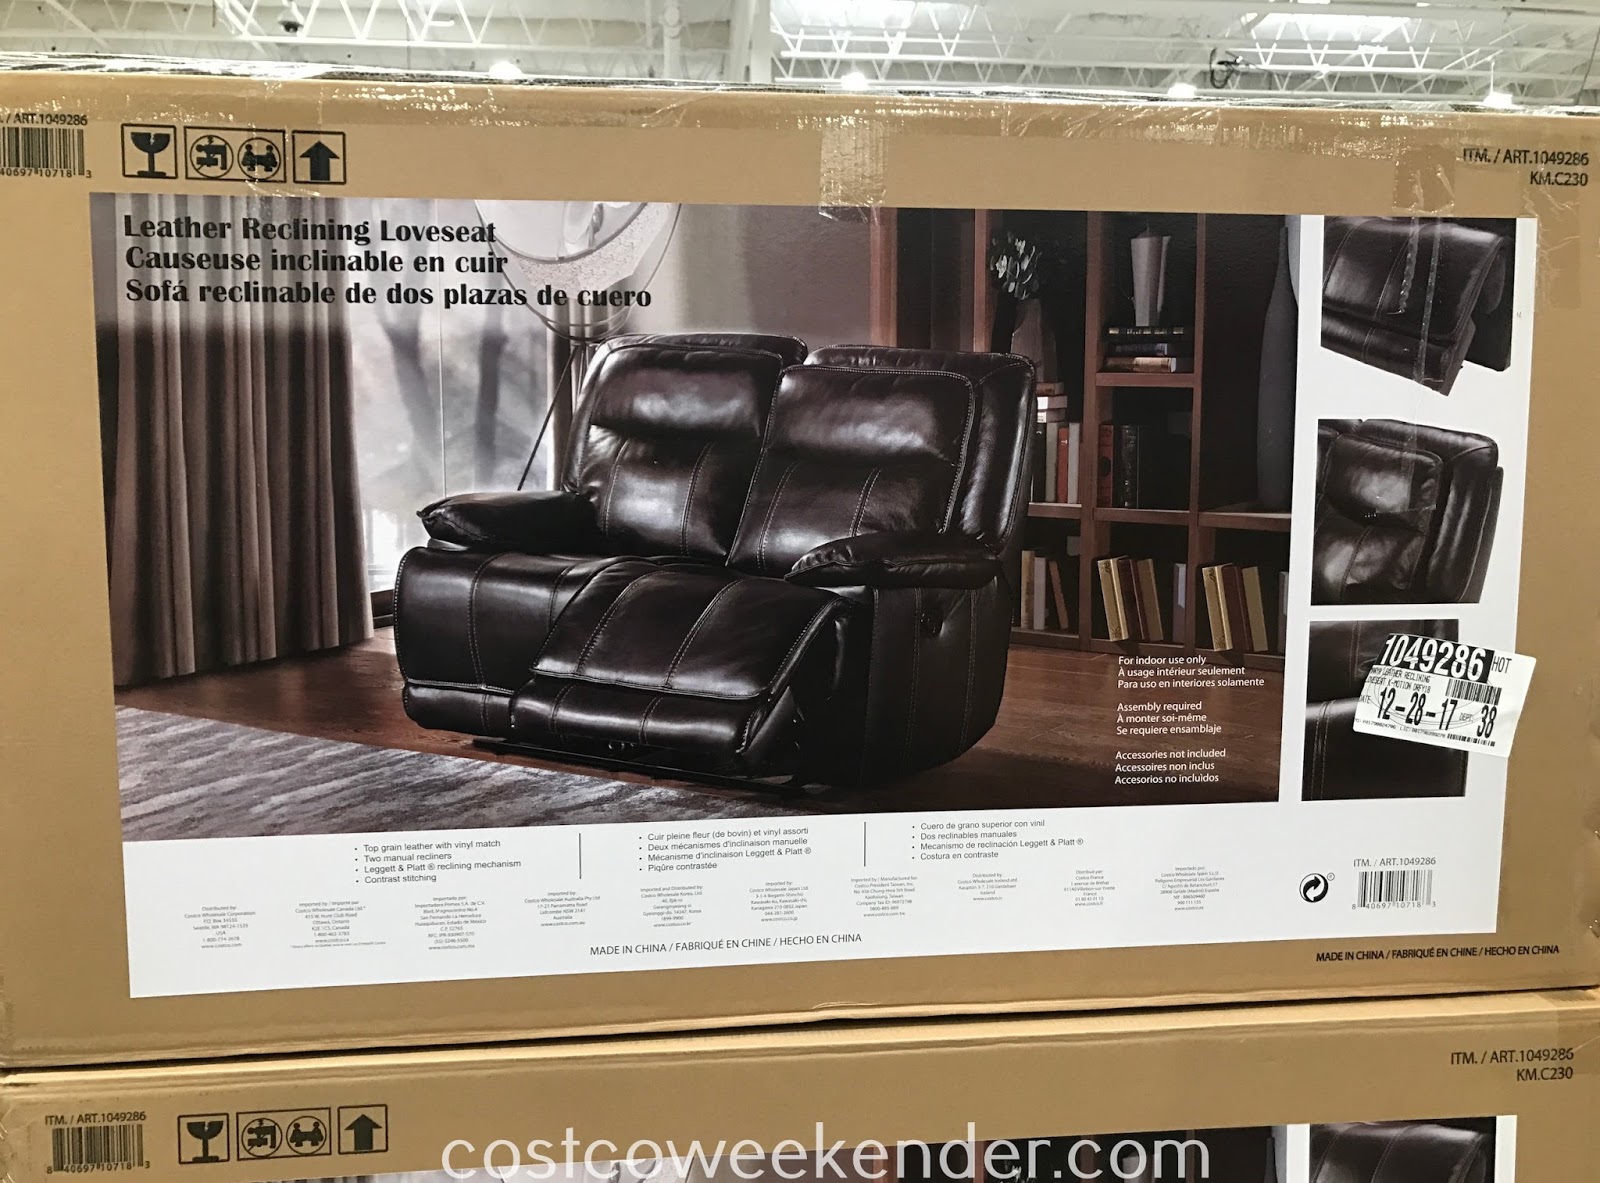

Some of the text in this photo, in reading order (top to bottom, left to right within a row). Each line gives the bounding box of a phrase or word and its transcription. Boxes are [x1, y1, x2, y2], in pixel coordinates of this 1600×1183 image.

[13, 113, 88, 126] ART.1049286
[1463, 148, 1491, 164] ITM.
[1502, 149, 1590, 167] ART.1049286
[40, 169, 72, 178] 10718
[86, 170, 92, 178] 3
[1529, 171, 1589, 187] KM.C230
[124, 215, 496, 246] Leather Reclining Loveseat
[125, 246, 508, 273] Causeuse inclinable en cuir
[126, 279, 652, 309] Sofá reclinable de dos plazas de cuero
[1118, 654, 1207, 666] For indoor use only
[1380, 634, 1512, 681] 1049286 HOT
[1117, 666, 1246, 678] À usage intérieur seulement
[1118, 678, 1265, 689] Para uso en interiores solamente
[1116, 701, 1202, 713] Assembly required
[1377, 687, 1458, 730] 12-28-17
[1476, 704, 1498, 739] 38
[1116, 712, 1208, 724] À monter soi-même
[1116, 724, 1222, 737] Se requiere ensamblaje
[1115, 748, 1226, 760] Accessories not included
[1115, 761, 1215, 772] Accessoires non inclus
[1114, 775, 1164, 785] Accesorios
[1164, 776, 1178, 784] no
[920, 822, 945, 831] Cuero
[945, 822, 956, 830] de
[957, 822, 980, 831] grano
[981, 821, 1013, 829] superior
[1029, 819, 1045, 827] vinil
[647, 827, 809, 842] Cuir pleine fleur (de bovin) et vinyl assorti
[920, 831, 1018, 841] Dos reclinables manuales
[363, 839, 501, 854] Top grain leather with vinyl match
[647, 843, 670, 852] Deux
[670, 842, 722, 850] mécanismes
[772, 837, 808, 846] manuelle
[965, 841, 976, 849] de
[977, 840, 1019, 849] reclinación
[1019, 840, 1049, 849] Leggett
[1049, 838, 1056, 847] &
[1057, 838, 1075, 846] Platt
[363, 853, 453, 863] Two manual recliners
[647, 853, 694, 862] Mécanisme
[745, 849, 776, 859] Leggett
[776, 848, 783, 856] &
[784, 847, 803, 856] Platt
[920, 852, 951, 861] Costura
[963, 851, 999, 859] contraste
[364, 861, 522, 875] Leggett & Platt reclining mechanism
[647, 862, 718, 873] Piqûre contrastée
[1353, 858, 1372, 868] ITM.
[1379, 857, 1437, 867] ART.1049286
[364, 874, 437, 884] Contrast stitching
[590, 945, 620, 956] MADE
[622, 945, 633, 955] IN
[634, 943, 668, 954] CHINA
[675, 939, 725, 951] FABRIQUÉ
[726, 939, 740, 949] EN
[741, 937, 772, 948] CHINE
[779, 935, 815, 946] HECHO
[816, 935, 830, 944] EN
[831, 933, 863, 944] CHINA
[1315, 951, 1344, 962] MADE
[1344, 951, 1355, 961] IN
[1355, 950, 1385, 961] CHINA
[1391, 947, 1435, 959] FABRIQUÉ
[1436, 948, 1449, 958] EN
[1449, 947, 1478, 958] CHINE
[1484, 946, 1517, 956] HECHO
[1517, 945, 1531, 956] EN
[1531, 945, 1560, 955] CHINA
[1450, 1051, 1479, 1065] ITM.
[1489, 1047, 1575, 1064] ART.1049286
[1516, 1066, 1574, 1082] KM.C230
[44, 1115, 68, 1126] ITM.
[76, 1111, 147, 1124] ART.1049286
[46, 1160, 151, 1175] 8 40697 10718 3
